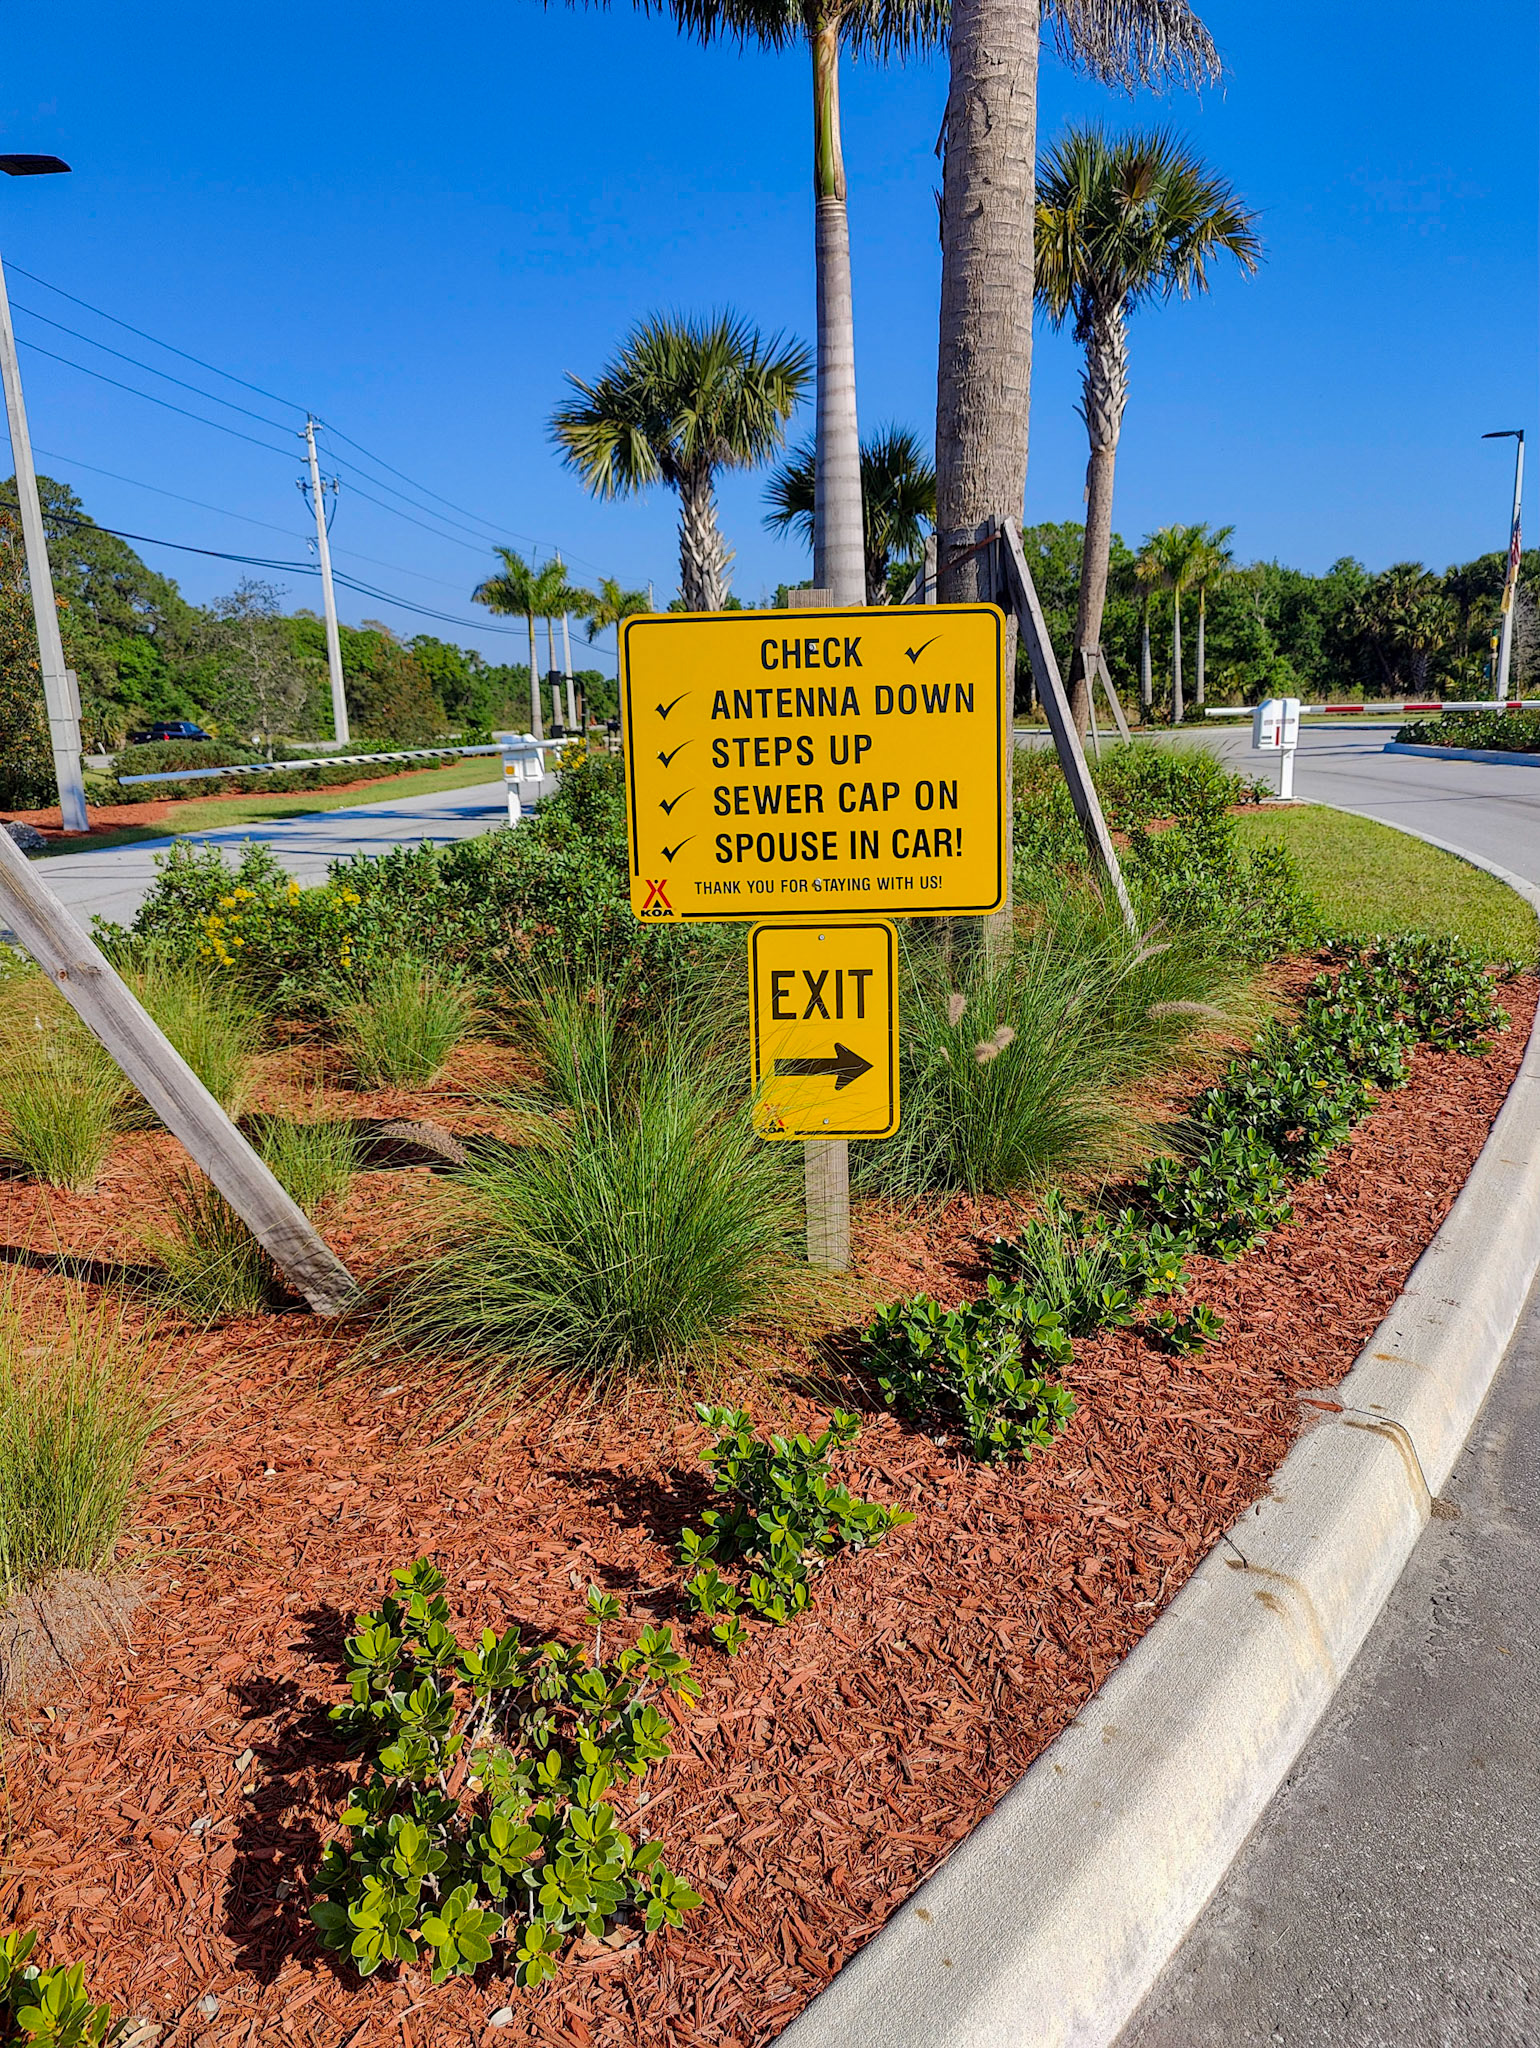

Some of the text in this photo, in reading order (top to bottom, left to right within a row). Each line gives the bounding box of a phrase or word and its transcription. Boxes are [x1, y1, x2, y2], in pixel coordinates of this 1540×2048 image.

[760, 636, 863, 671] CHECK
[711, 682, 974, 720] ANTENNA DOWN
[712, 734, 873, 769] STEPS UP
[713, 779, 958, 817] SEWER CAP ON
[715, 827, 962, 864] SPOUSE IN CAR!
[694, 875, 942, 895] THANK YOU FOR STAYING WITH US!
[640, 908, 675, 917] KOA
[771, 968, 873, 1021] EXIT
